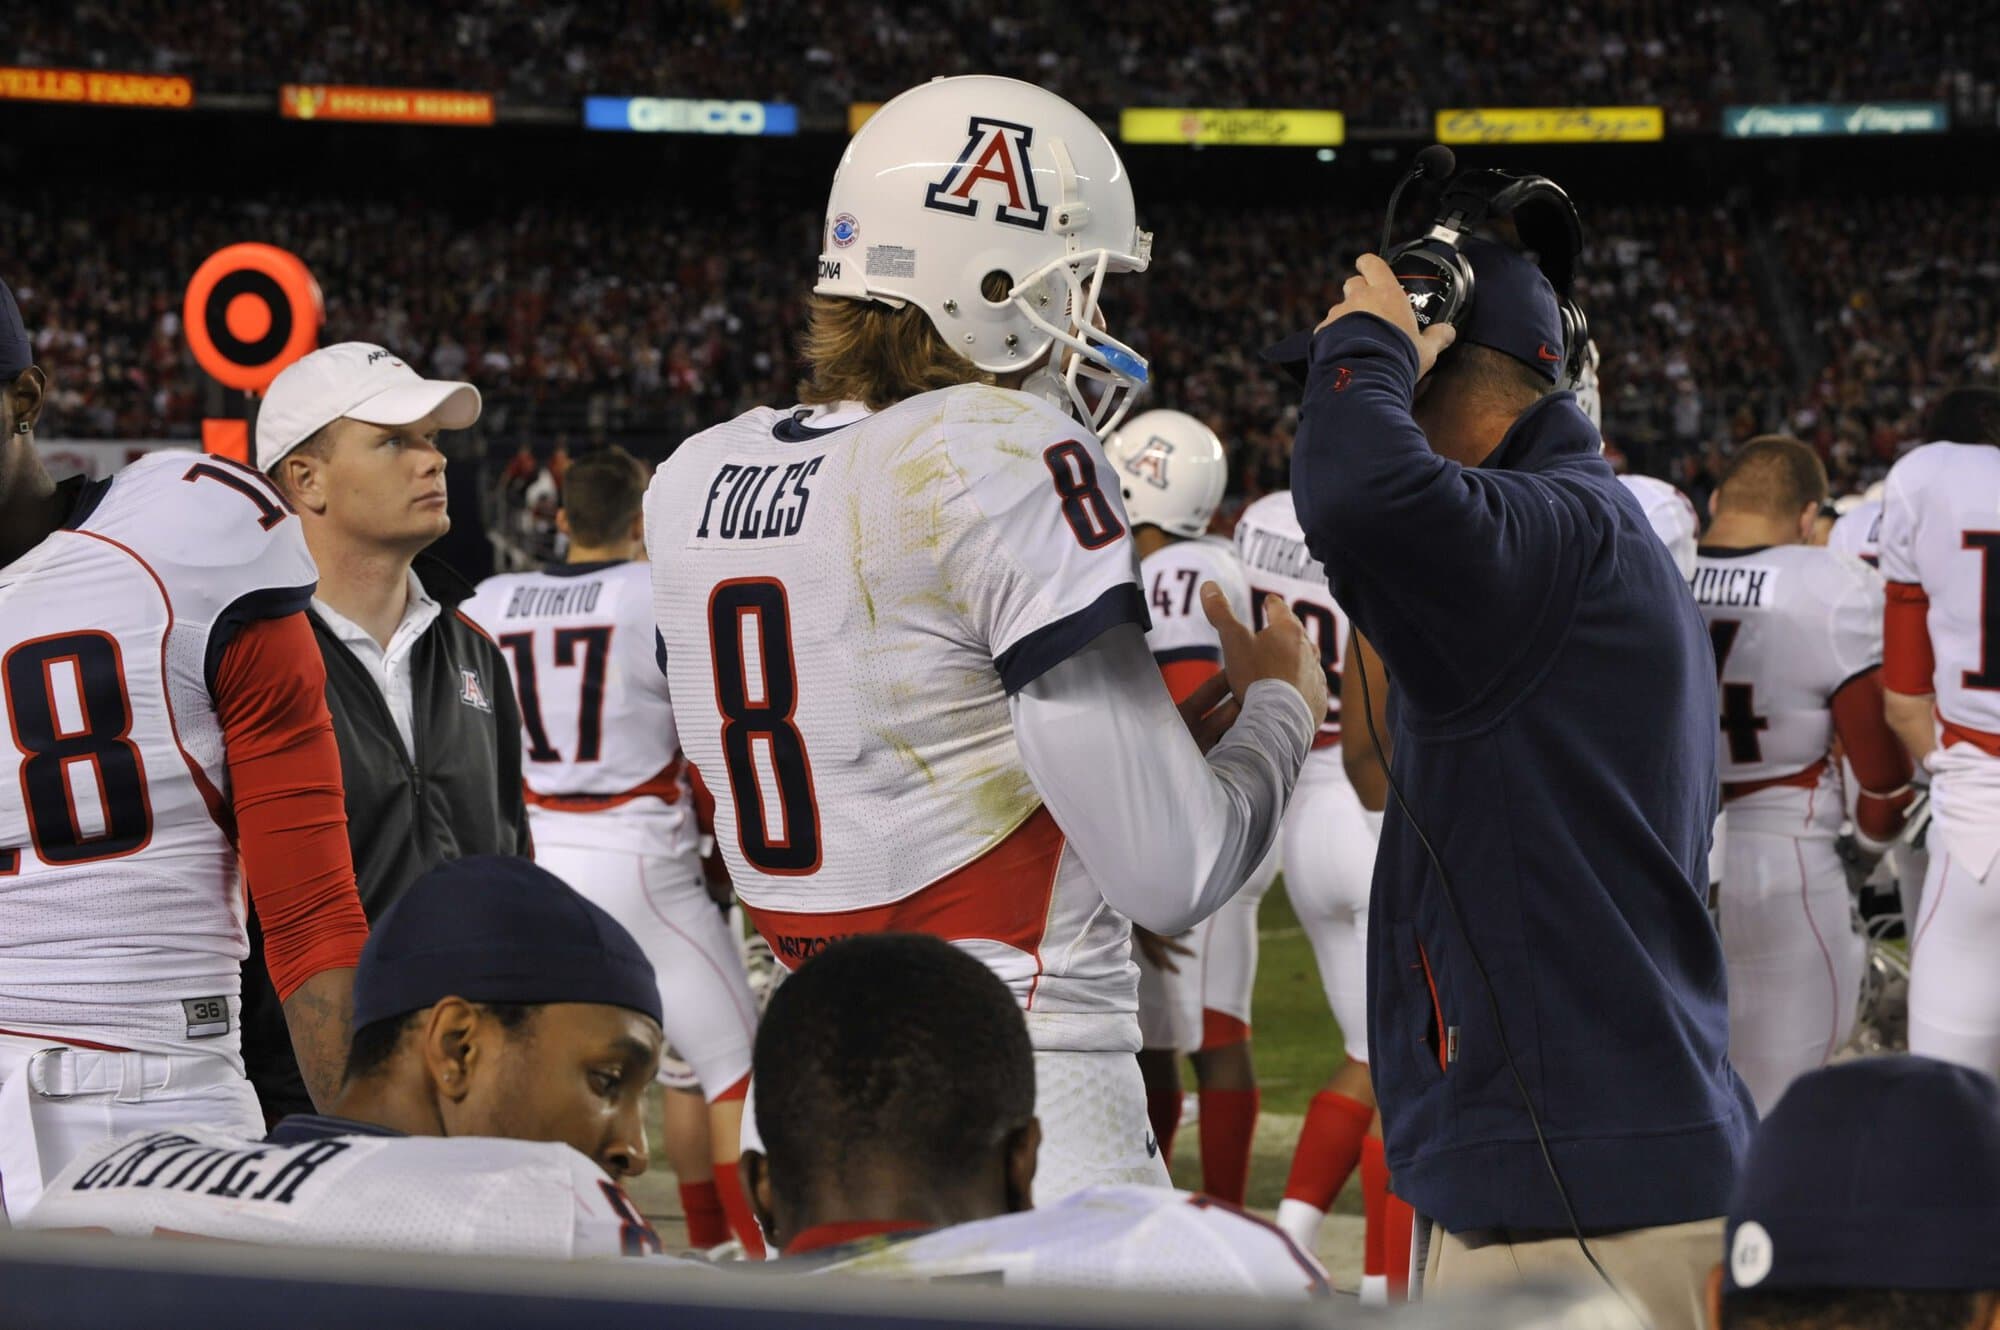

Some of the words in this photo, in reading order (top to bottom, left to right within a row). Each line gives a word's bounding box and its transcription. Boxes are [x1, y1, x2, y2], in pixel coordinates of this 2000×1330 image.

[924, 115, 1048, 231] A
[696, 455, 826, 540] FOLES
[1043, 439, 1125, 550] 8
[1152, 570, 1200, 617] 47
[498, 623, 617, 764] 17
[707, 576, 823, 877] 8
[0, 629, 153, 876] 8
[194, 1002, 220, 1019] 36
